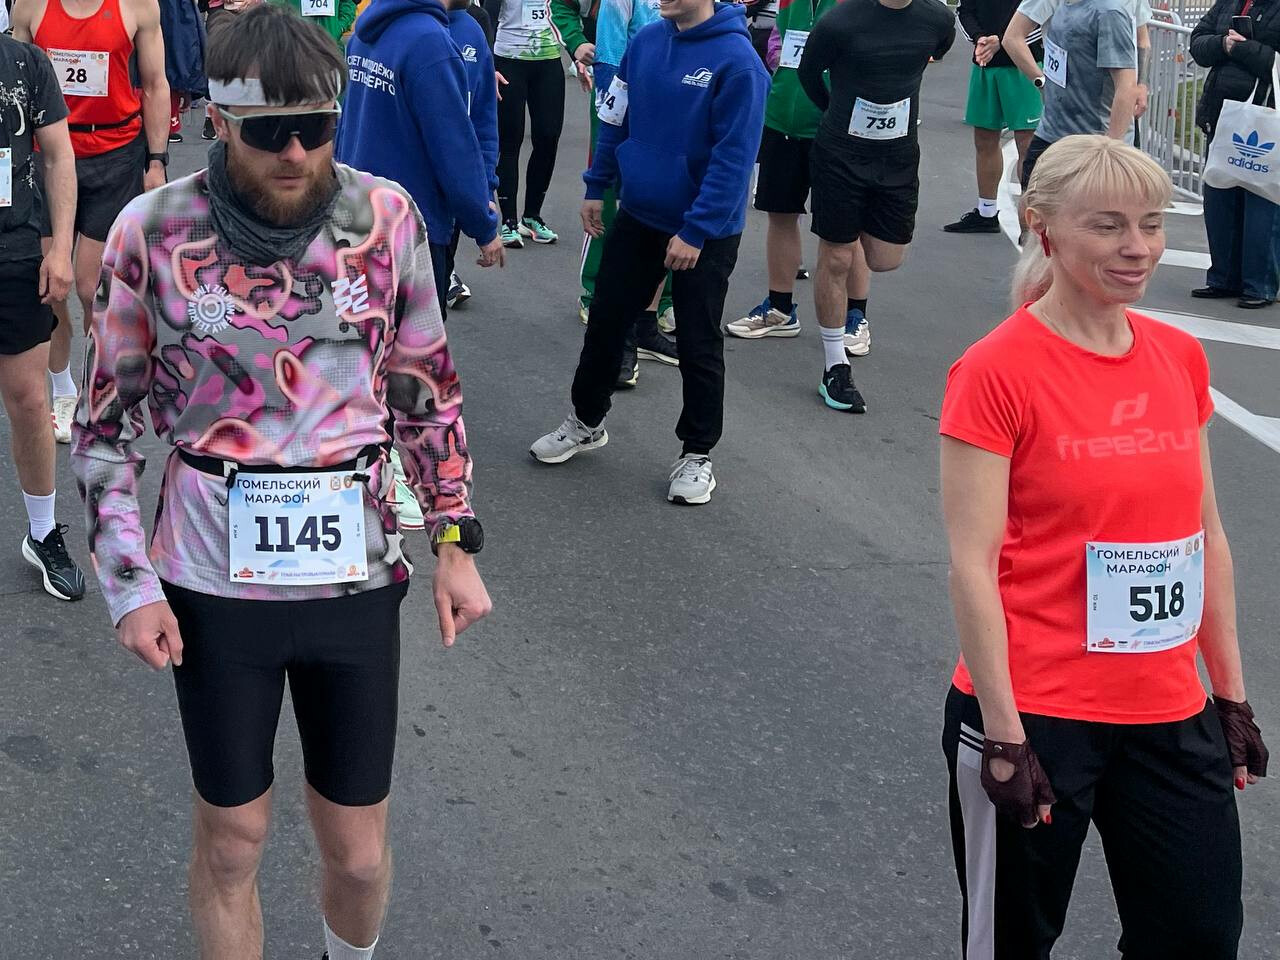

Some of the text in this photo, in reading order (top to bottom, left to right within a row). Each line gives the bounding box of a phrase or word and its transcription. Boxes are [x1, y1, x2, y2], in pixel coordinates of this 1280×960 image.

[310, 0, 328, 9] 704
[66, 68, 87, 83] 28
[867, 116, 896, 130] 738
[1228, 155, 1269, 173] adidas
[237, 478, 320, 490] ГОМЕЛЬСКИЙ
[245, 494, 310, 503] МАРАФОН
[255, 515, 342, 552] 1145
[1097, 547, 1180, 560] ГОМЕЛЬСКИЙ
[1107, 563, 1171, 574] МАРАФОН
[1129, 581, 1184, 622] 518
